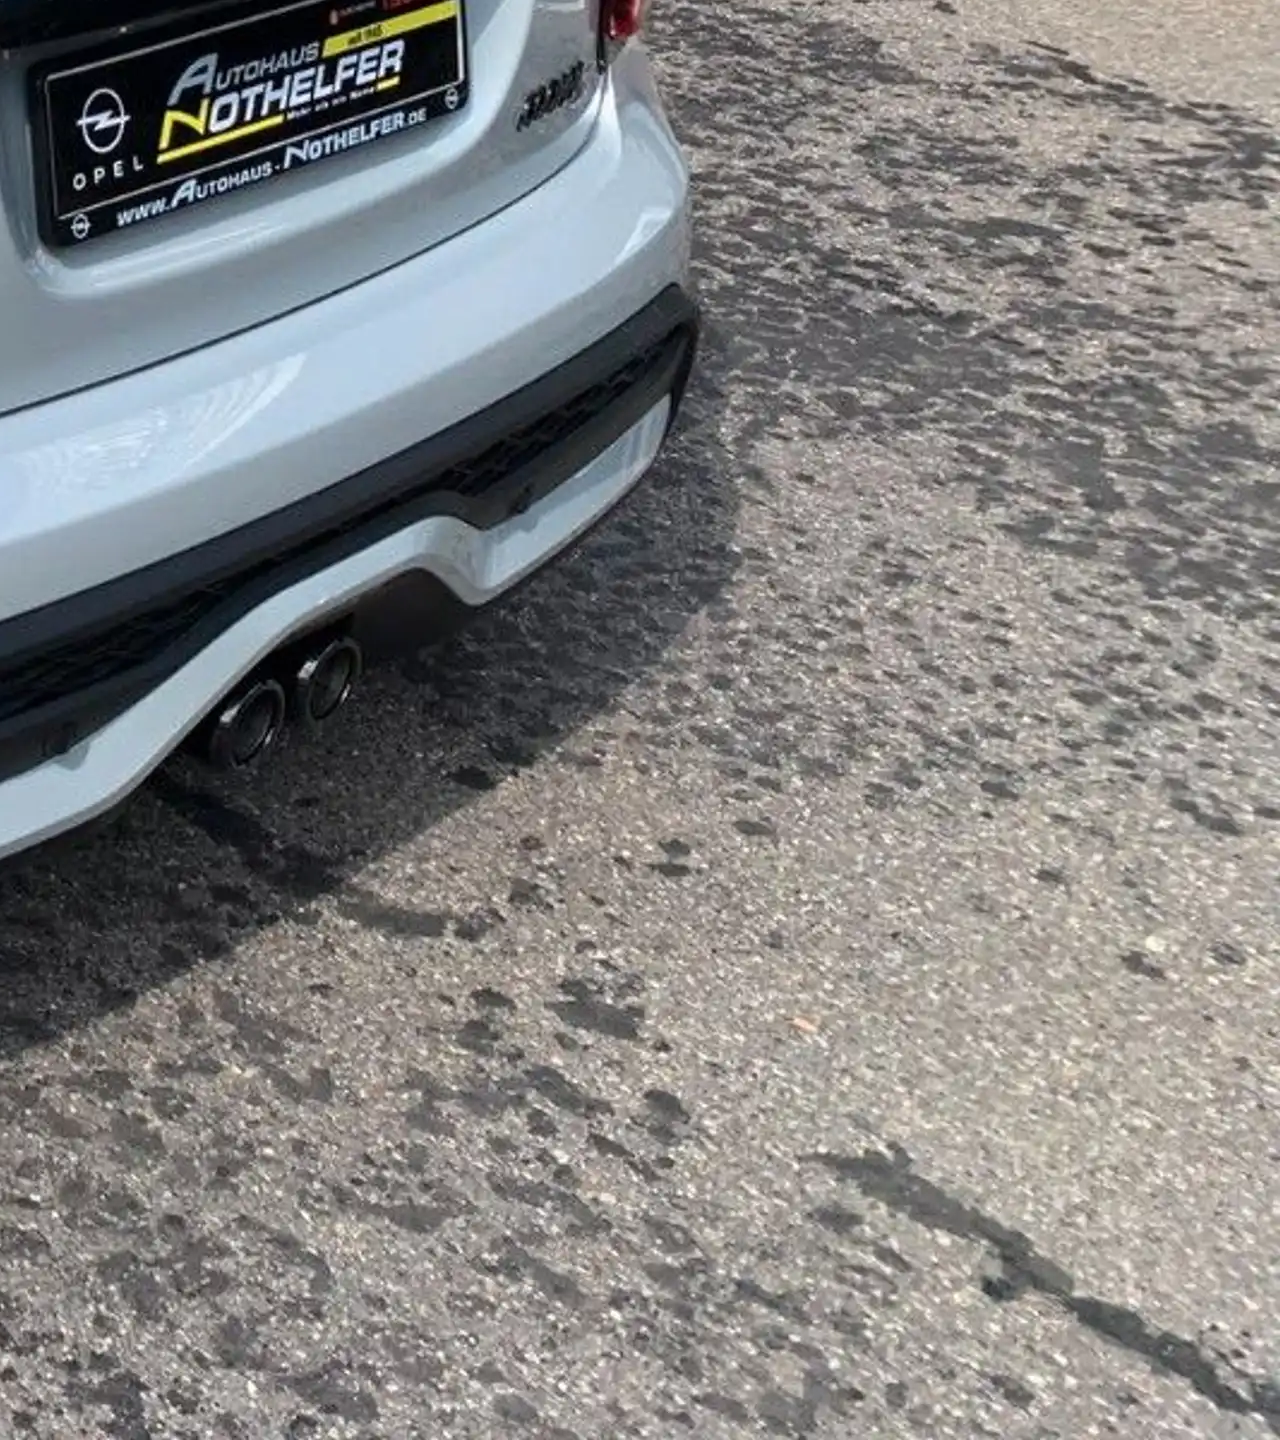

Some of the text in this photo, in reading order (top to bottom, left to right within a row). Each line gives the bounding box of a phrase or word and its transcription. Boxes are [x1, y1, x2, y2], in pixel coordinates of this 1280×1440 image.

[158, 37, 407, 150] NOTHELFER
[167, 40, 320, 106] AUTOHAUS
[72, 155, 144, 191] OPEL
